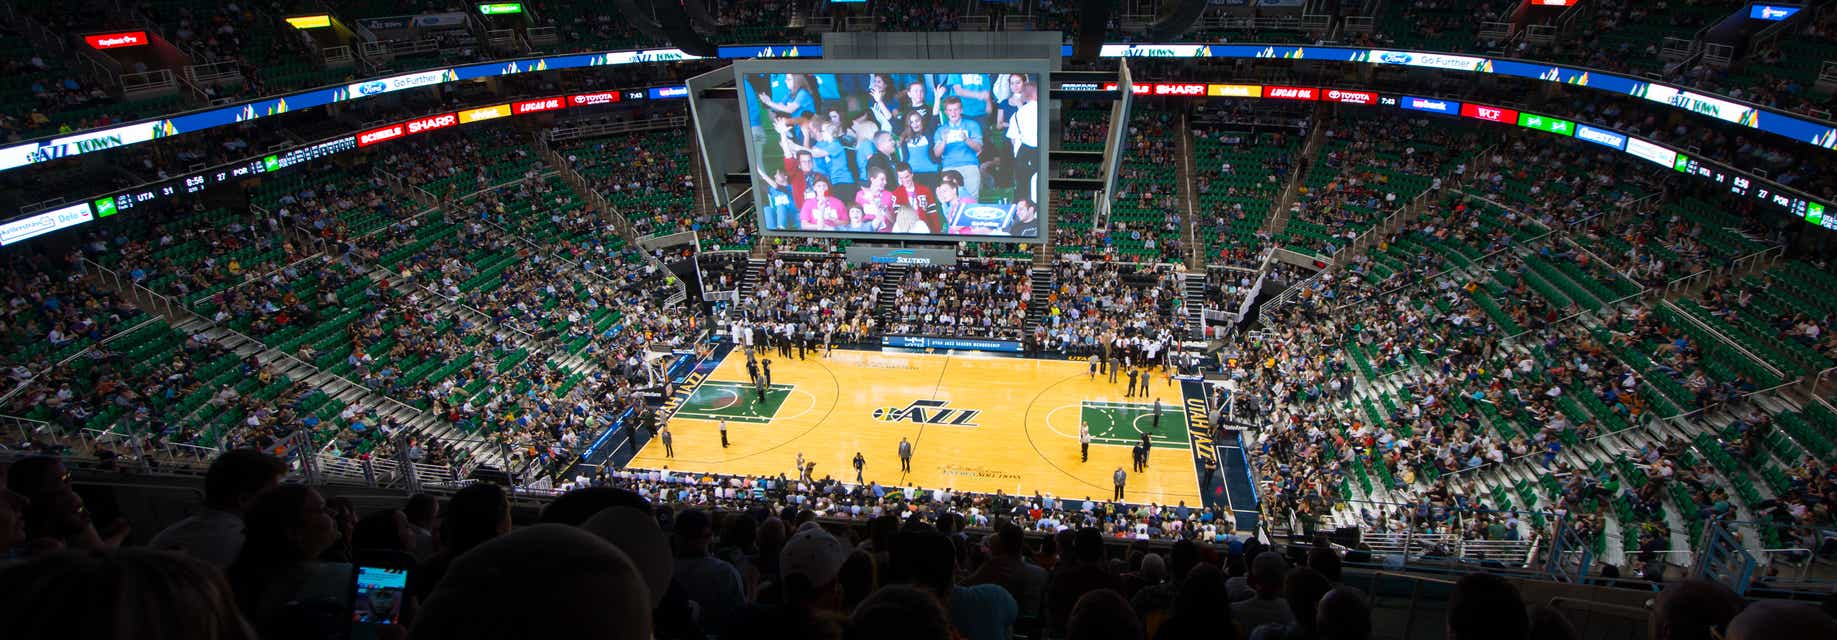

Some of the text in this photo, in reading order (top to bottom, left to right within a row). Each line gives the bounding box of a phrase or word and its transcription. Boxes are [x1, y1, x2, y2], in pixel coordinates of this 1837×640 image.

[656, 53, 683, 61] TOWN
[1382, 52, 1410, 64] Ford
[1420, 55, 1470, 68] Go Further
[361, 81, 386, 95] Ford
[393, 75, 437, 88] Go Further
[1155, 84, 1205, 95] SHARP
[1271, 88, 1311, 98] LUCAS OIL
[585, 93, 613, 102] TOYOTA
[1341, 92, 1370, 101] TOYOTA
[520, 99, 559, 112] LUCAS OIL
[1693, 99, 1720, 117] TOWN
[1477, 106, 1501, 119] WCF
[408, 114, 456, 133] SHARP
[360, 126, 402, 144] SCHEELS
[73, 133, 123, 154] TOWN
[233, 167, 248, 176] POR
[137, 191, 155, 202] UTA
[162, 186, 174, 196] 31
[1772, 194, 1789, 207] POR
[873, 399, 983, 428] JAZZ
[1187, 398, 1209, 429] UTAH
[1190, 429, 1217, 462] JAZZ
